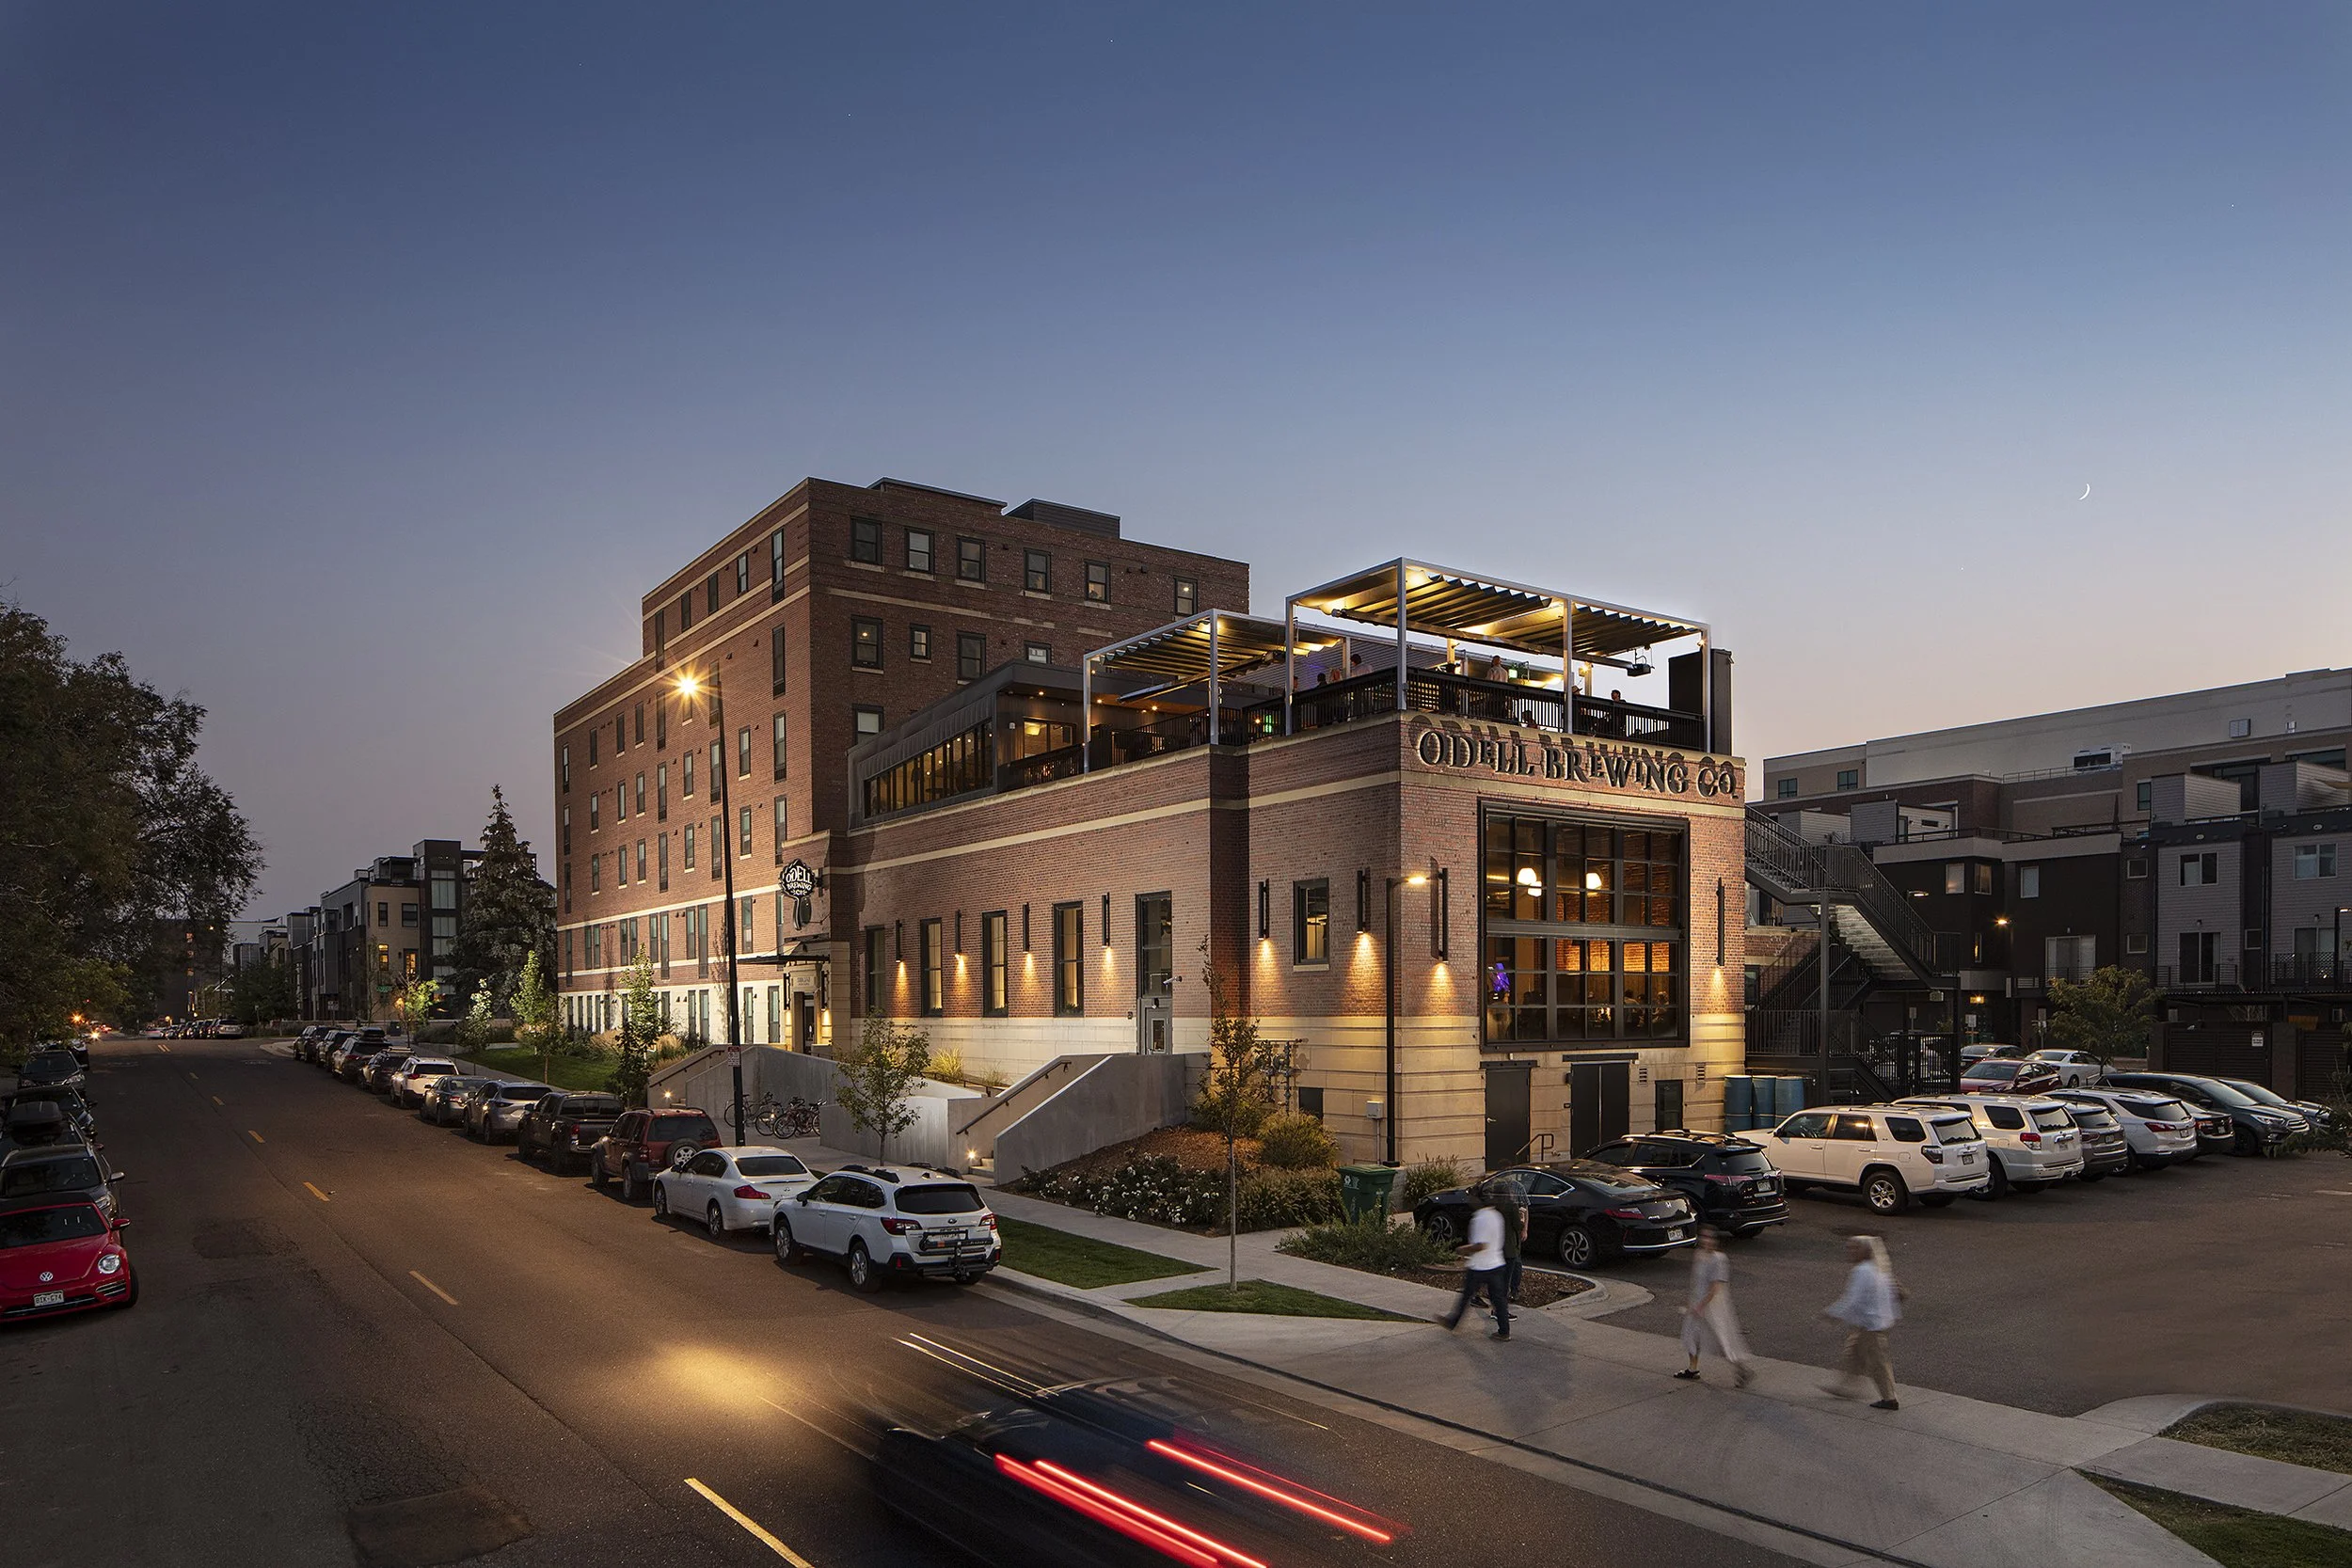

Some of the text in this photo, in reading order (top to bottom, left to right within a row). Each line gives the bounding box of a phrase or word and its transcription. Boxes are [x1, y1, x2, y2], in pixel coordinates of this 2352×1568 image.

[1419, 730, 1534, 775] ODELL
[1544, 747, 1689, 794] BREWING
[786, 866, 812, 884] ODELL
[787, 881, 812, 891] BREWING
